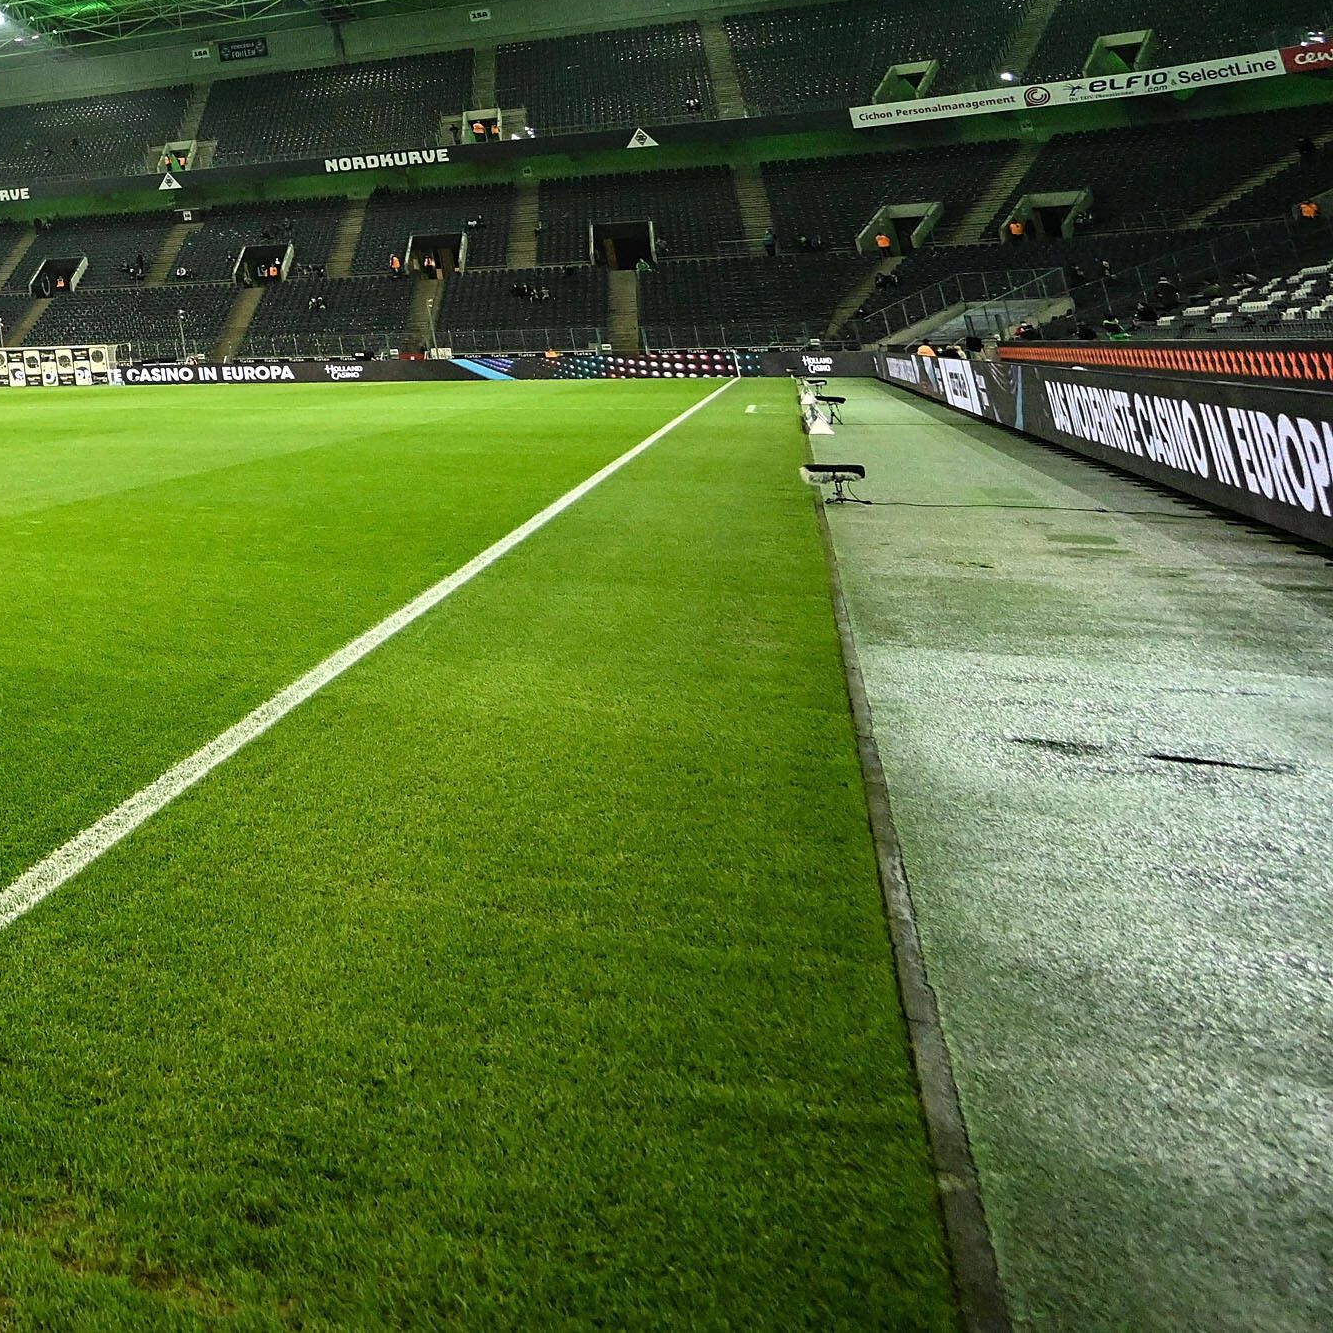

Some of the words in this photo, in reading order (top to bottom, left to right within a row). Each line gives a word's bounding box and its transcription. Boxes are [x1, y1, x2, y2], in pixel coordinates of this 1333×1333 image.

[1178, 59, 1277, 84] SelectLine
[859, 110, 893, 122] Cichon
[895, 95, 1016, 116] Personalmanagement
[324, 148, 449, 173] NORDKURVE
[324, 364, 363, 373] HOLLAND
[802, 355, 833, 365] HOLLAND
[808, 364, 832, 373] CASINO
[127, 368, 193, 383] CASINO
[197, 367, 217, 381] IN
[220, 365, 295, 381] EUROPA
[330, 371, 360, 380] CASINO
[1045, 381, 1072, 435] DAS
[1066, 383, 1143, 457] MODERNSTE
[1134, 393, 1209, 479] CASINO
[1199, 403, 1241, 488] IN
